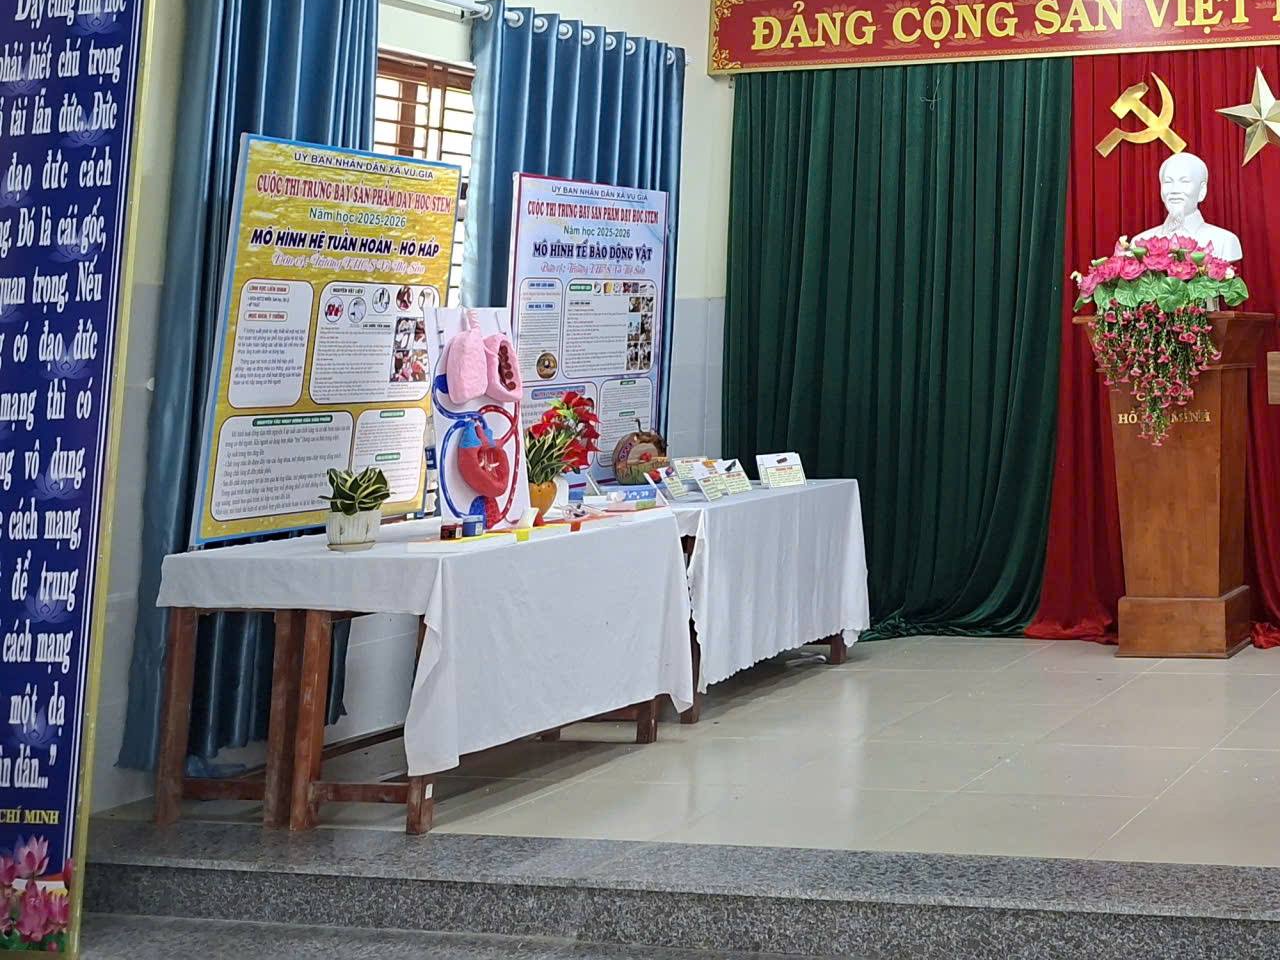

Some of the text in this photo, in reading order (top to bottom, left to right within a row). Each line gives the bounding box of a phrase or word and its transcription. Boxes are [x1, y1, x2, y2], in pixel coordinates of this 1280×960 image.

[750, 0, 876, 51] ĐẢNG
[28, 35, 123, 85] biết chú trọng
[9, 96, 27, 137] tài
[31, 87, 52, 135] lẫn
[90, 90, 118, 131] Đức
[7, 145, 112, 200] đạo đức cách
[16, 207, 36, 248] Đó
[39, 206, 52, 246] là
[57, 204, 78, 247] cái
[80, 197, 107, 254] gốc,
[75, 254, 103, 302] Nếu
[13, 318, 98, 370] có đạo đức
[0, 377, 93, 431] mạng thì có
[1118, 409, 1138, 423] HỒ
[25, 439, 41, 481] vô
[8, 497, 38, 540] cách
[11, 549, 79, 612] để trung
[3, 618, 73, 674] cách mạng
[9, 681, 66, 737] một dạ
[23, 809, 60, 825] MINH
